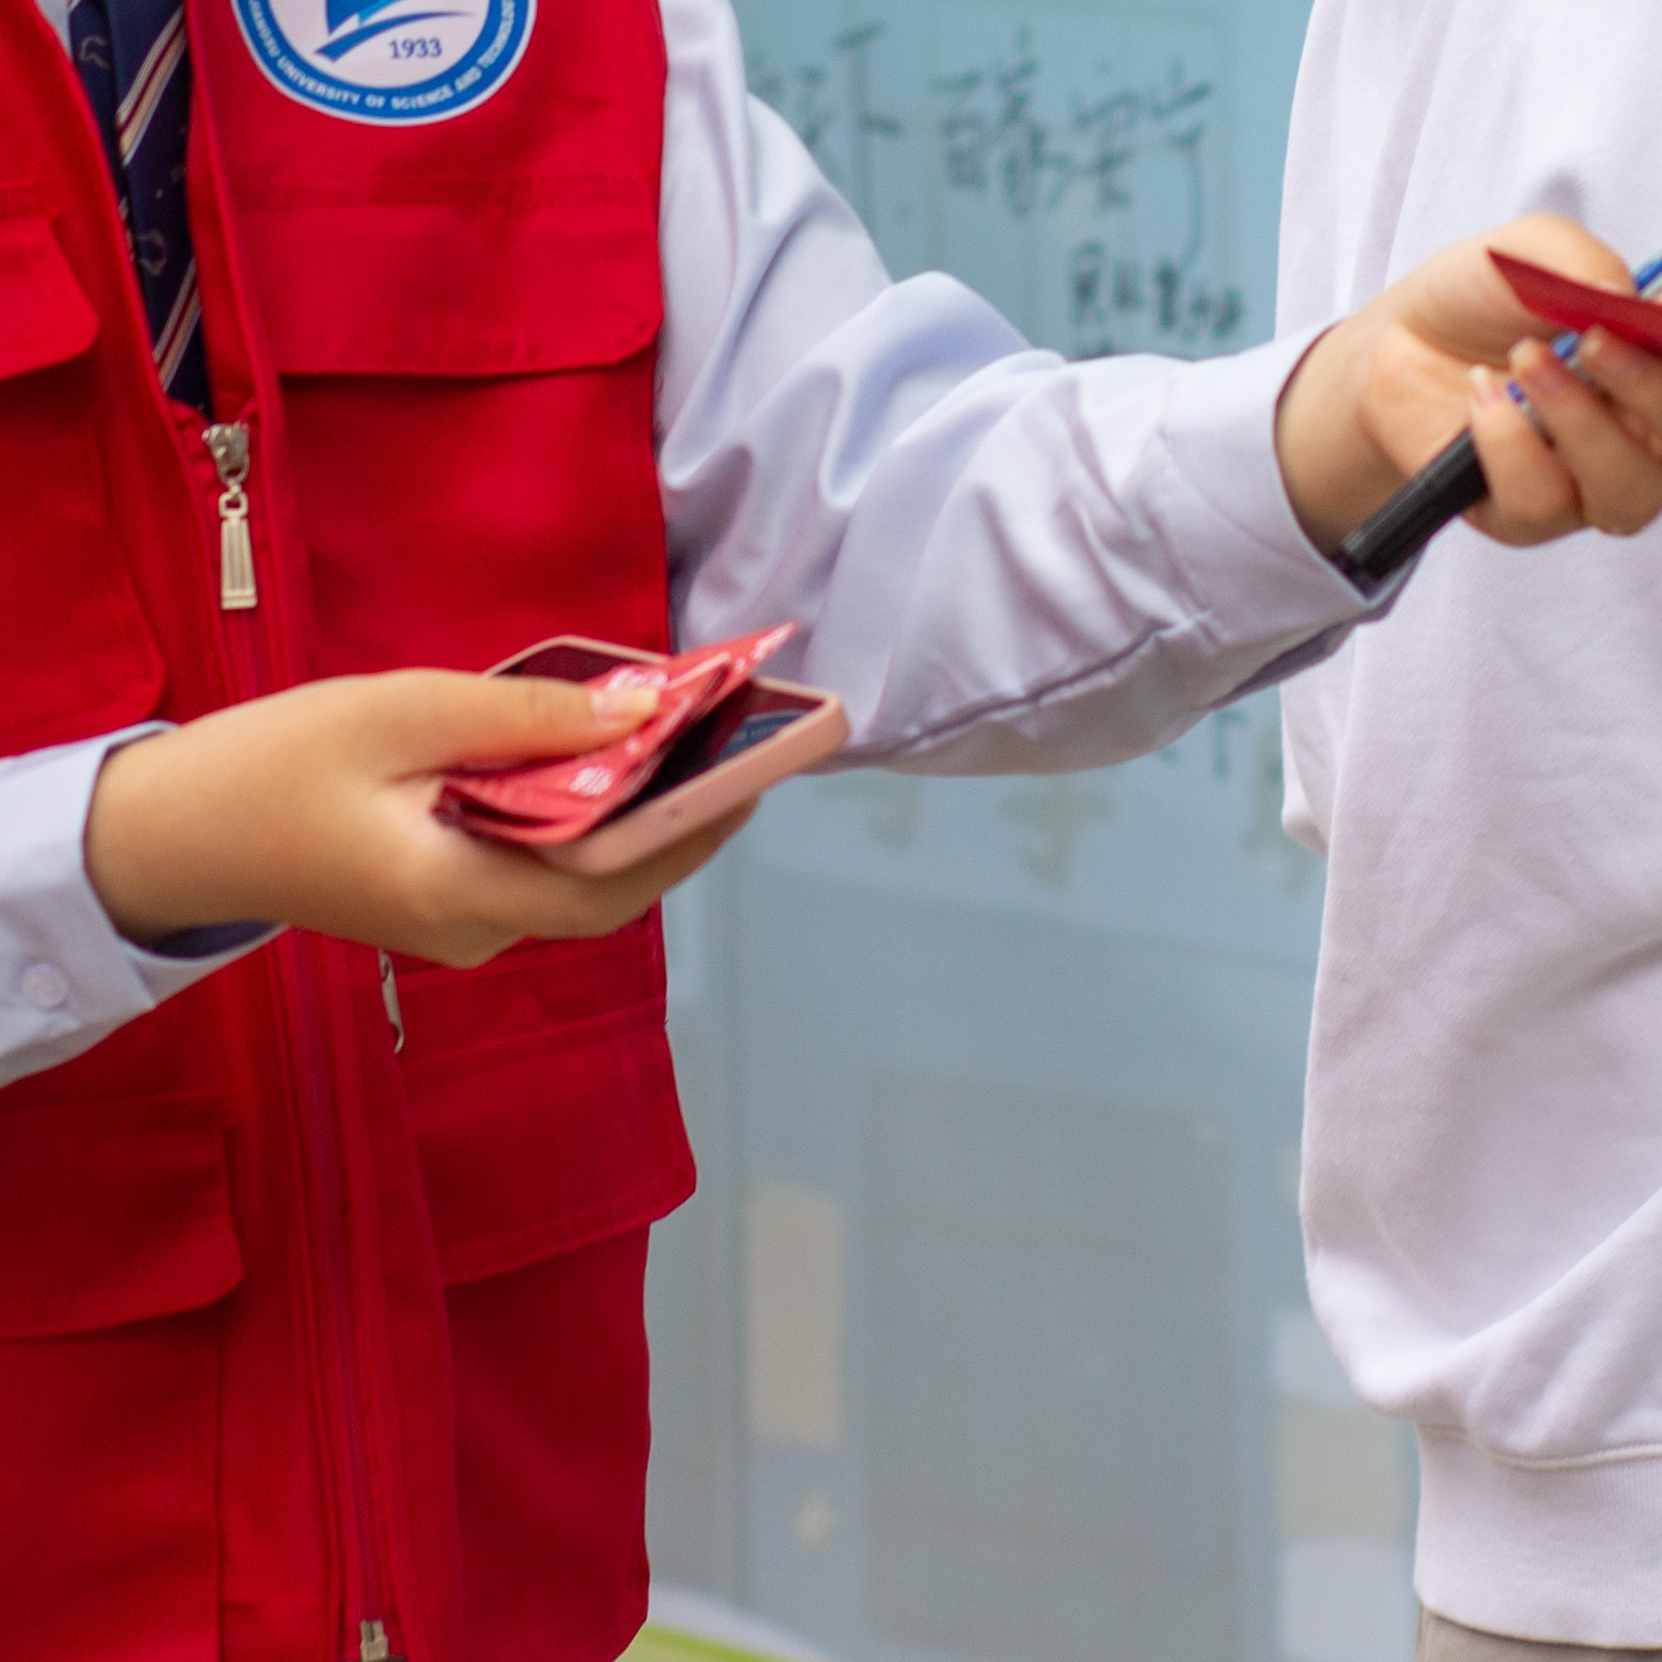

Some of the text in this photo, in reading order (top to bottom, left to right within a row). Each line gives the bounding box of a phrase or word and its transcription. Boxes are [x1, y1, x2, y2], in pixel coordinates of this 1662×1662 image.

[389, 37, 443, 60] 1933
[276, 55, 361, 106] UNIVERSITY
[365, 93, 386, 109] OF
